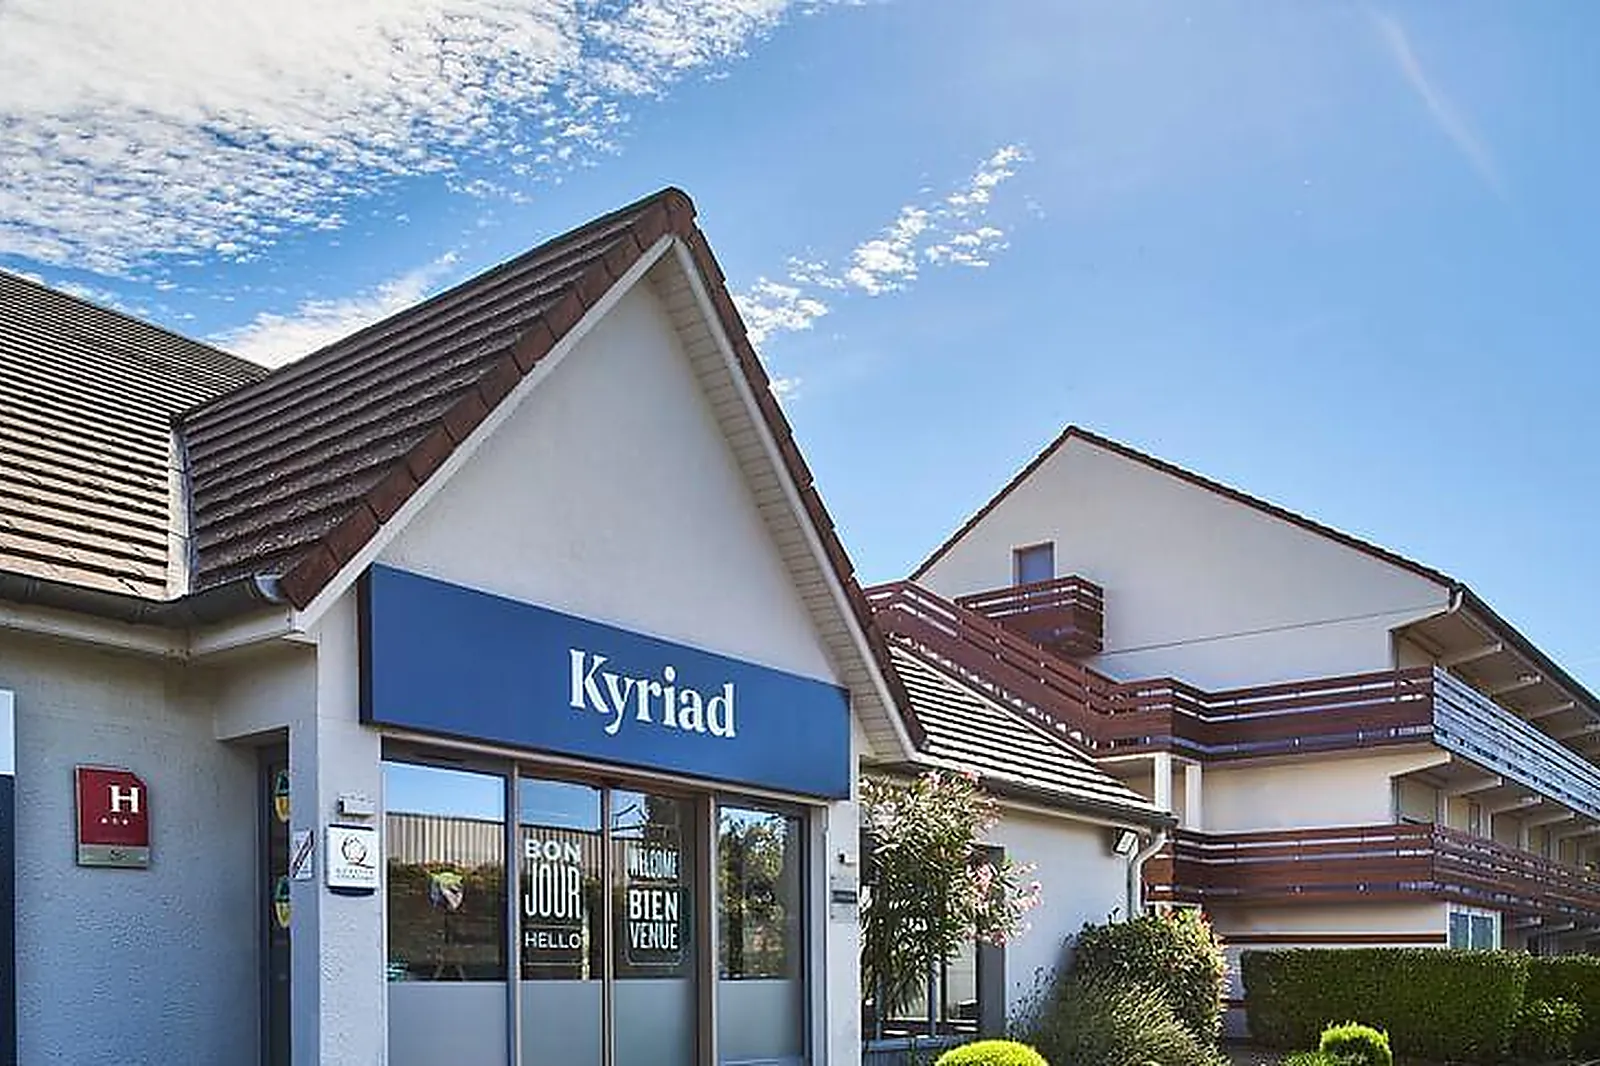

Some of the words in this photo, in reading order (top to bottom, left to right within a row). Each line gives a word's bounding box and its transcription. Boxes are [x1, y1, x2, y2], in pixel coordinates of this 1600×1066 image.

[569, 649, 736, 738] Kyriad
[110, 785, 139, 813] H
[525, 839, 581, 863] BON
[629, 846, 678, 879] WELCOME
[525, 862, 581, 919] JOUR
[629, 889, 678, 921] BIEN
[525, 931, 581, 949] HELLO
[629, 921, 679, 949] VENUE
